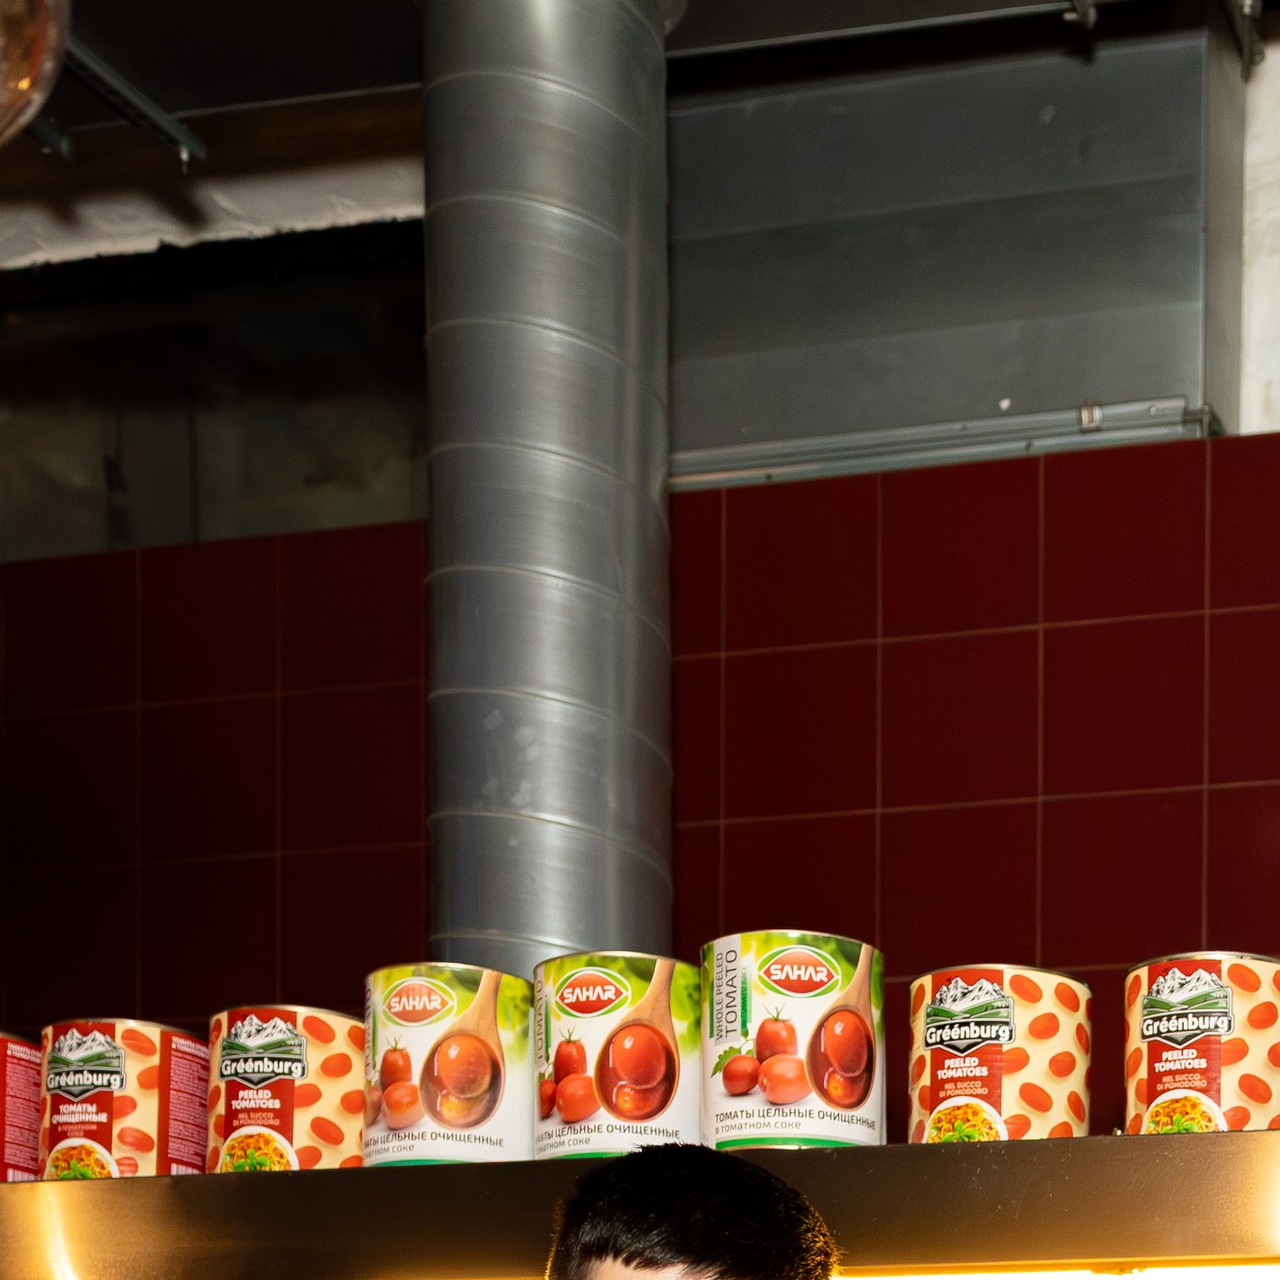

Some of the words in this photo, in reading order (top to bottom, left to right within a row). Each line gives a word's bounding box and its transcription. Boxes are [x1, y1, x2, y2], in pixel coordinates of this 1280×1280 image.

[716, 952, 724, 996] PEELED
[769, 964, 829, 983] SAHAR
[563, 985, 617, 1004] SAHAR
[725, 949, 738, 1038] TOMATO
[390, 996, 442, 1013] SAHAR
[716, 1000, 724, 1041] WHOLE
[1142, 1014, 1228, 1036] Gréénburg
[926, 1022, 1010, 1044] Gréénburg
[1162, 1049, 1197, 1061] PEELED
[944, 1057, 979, 1069] PEELED
[1154, 1059, 1208, 1073] TOMATOES
[937, 1067, 988, 1080] TOMATOES
[1175, 1073, 1200, 1081] SUCCO
[957, 1081, 981, 1089] SUCCO
[1165, 1080, 1207, 1090] POMODORO
[238, 1090, 272, 1099] PEELED
[947, 1088, 988, 1096] POMODORO
[59, 1103, 97, 1114] ТОМАТЫ
[231, 1099, 281, 1110] TOMATOES
[715, 1109, 755, 1123] ТОМАТЫ
[758, 1108, 815, 1119] ЦЕЛЬНЫЕ
[818, 1110, 876, 1131] ОЧИЩЕННЫЕ
[555, 1124, 603, 1138] ЦЕЛЬНЫЕ
[606, 1124, 680, 1139] ОЧИЩЕННЫЕ
[721, 1121, 771, 1133] томатном
[774, 1121, 801, 1129] соке
[380, 1131, 427, 1145] ЦЕЛЬНЫЕ
[430, 1131, 504, 1148] ОЧИЩЕННЫЕ
[567, 1137, 591, 1147] соке
[391, 1145, 415, 1153] соке
